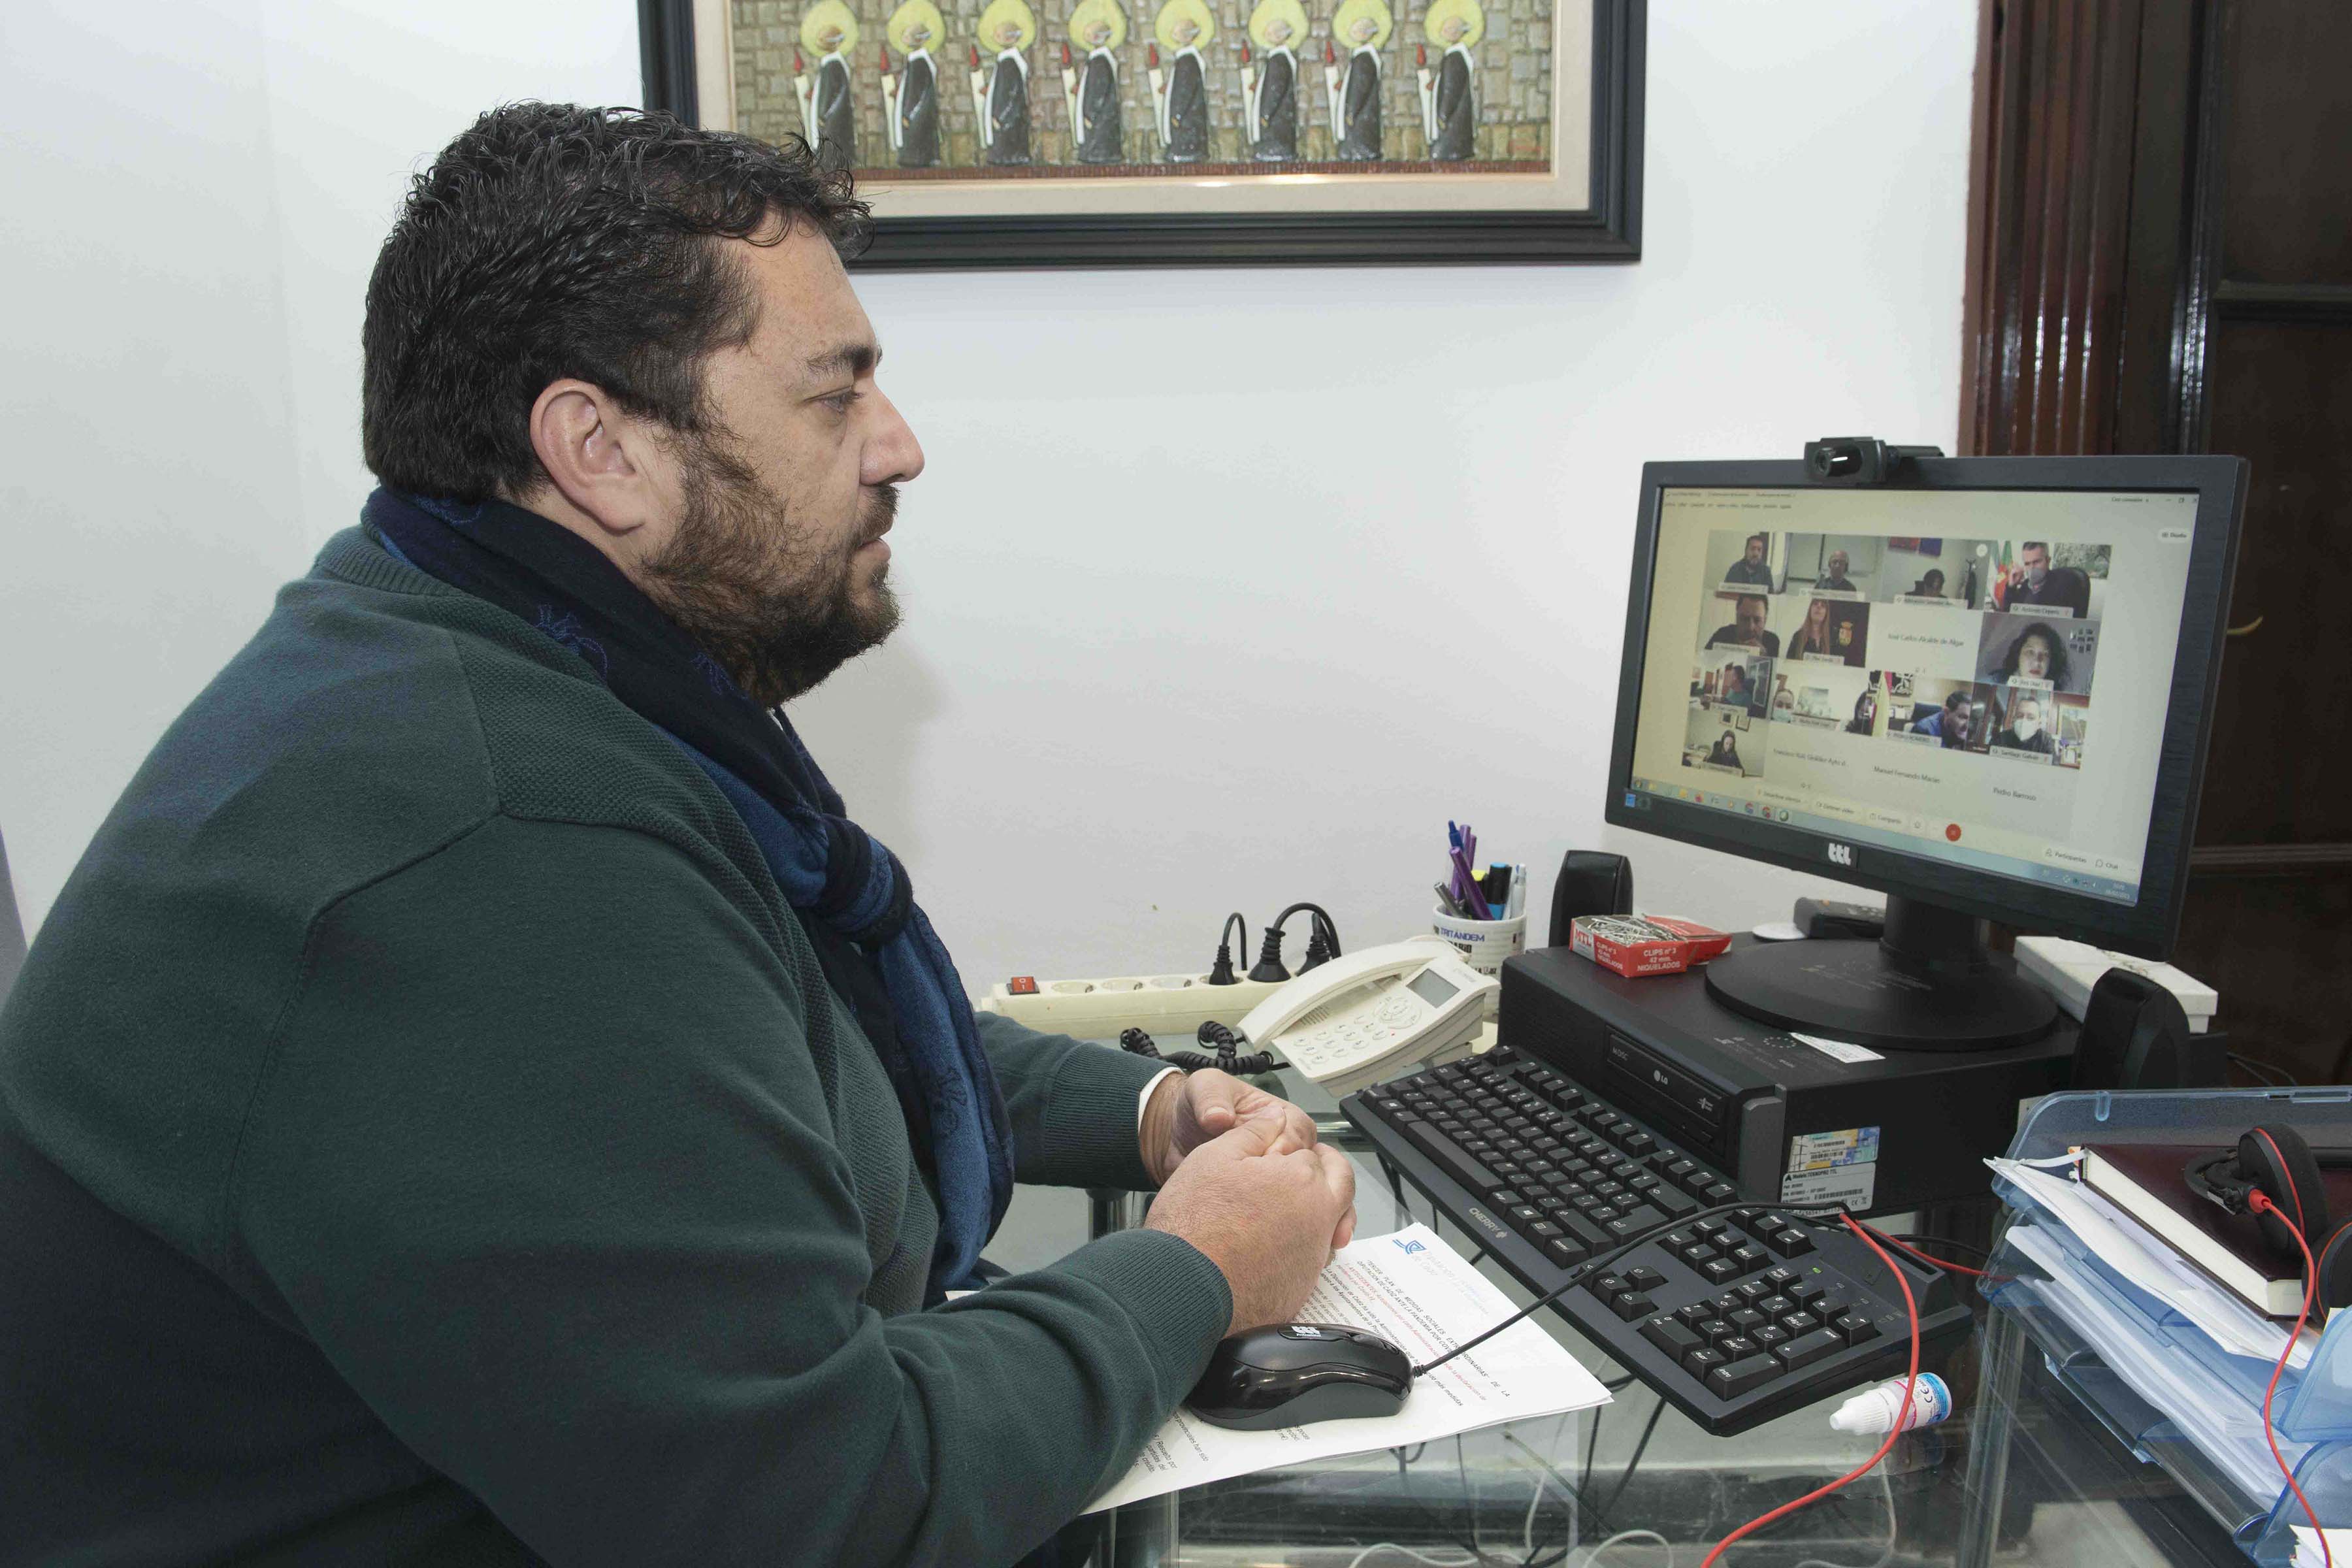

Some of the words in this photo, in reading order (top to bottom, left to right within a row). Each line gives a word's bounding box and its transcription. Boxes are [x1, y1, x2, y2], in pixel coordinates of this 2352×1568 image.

[1918, 636, 1939, 644] Alcalde
[1874, 765, 1893, 775] Manuel
[1894, 768, 1920, 780] Fernando
[1993, 787, 2012, 797] Pedro
[2012, 791, 2037, 801] Barroso
[2106, 861, 2118, 870] Chat
[1575, 927, 1592, 947] MTL
[1596, 941, 1609, 952] CLIPS
[1643, 949, 1663, 957] CLIPS
[1637, 960, 1681, 972] NIQUELADOS
[1469, 1207, 1498, 1233] CHERRY
[1394, 1297, 1407, 1307] ANTE
[1409, 1312, 1431, 1331] PANDEMIA
[1429, 1331, 1440, 1340] POR
[1382, 1276, 1396, 1286] PLAN
[1404, 1297, 1424, 1313] MEDIDAS
[1422, 1315, 1446, 1334] SOCIALES
[1446, 1337, 1492, 1377] EXTRORDINARIAS"
[1404, 1351, 1414, 1360] que
[1443, 1389, 1463, 1407] medidas
